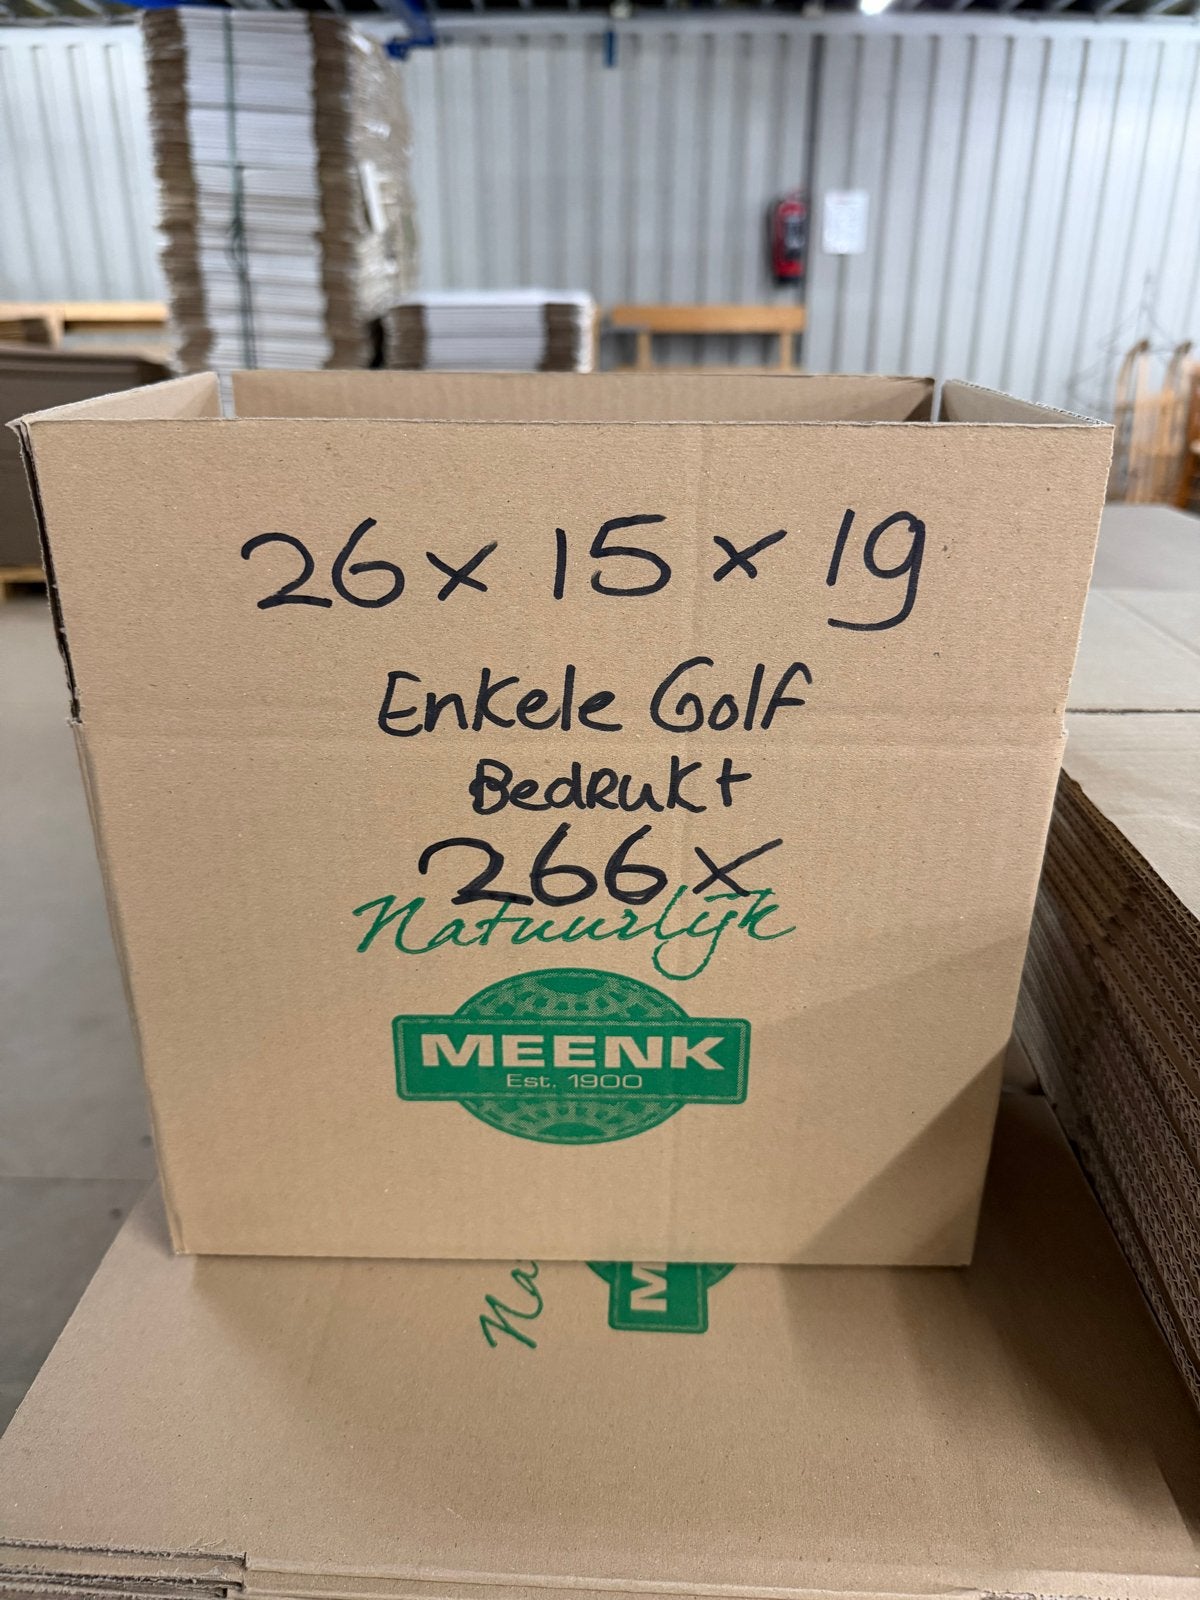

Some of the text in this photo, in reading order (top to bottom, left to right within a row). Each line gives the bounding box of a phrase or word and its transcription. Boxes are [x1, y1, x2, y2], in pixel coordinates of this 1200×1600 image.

[240, 517, 405, 610] 26
[553, 514, 672, 600] 15
[826, 508, 926, 632] 19
[649, 656, 813, 733] Golf
[421, 1033, 725, 1070] MEENK
[506, 1073, 643, 1090] Est. 1900
